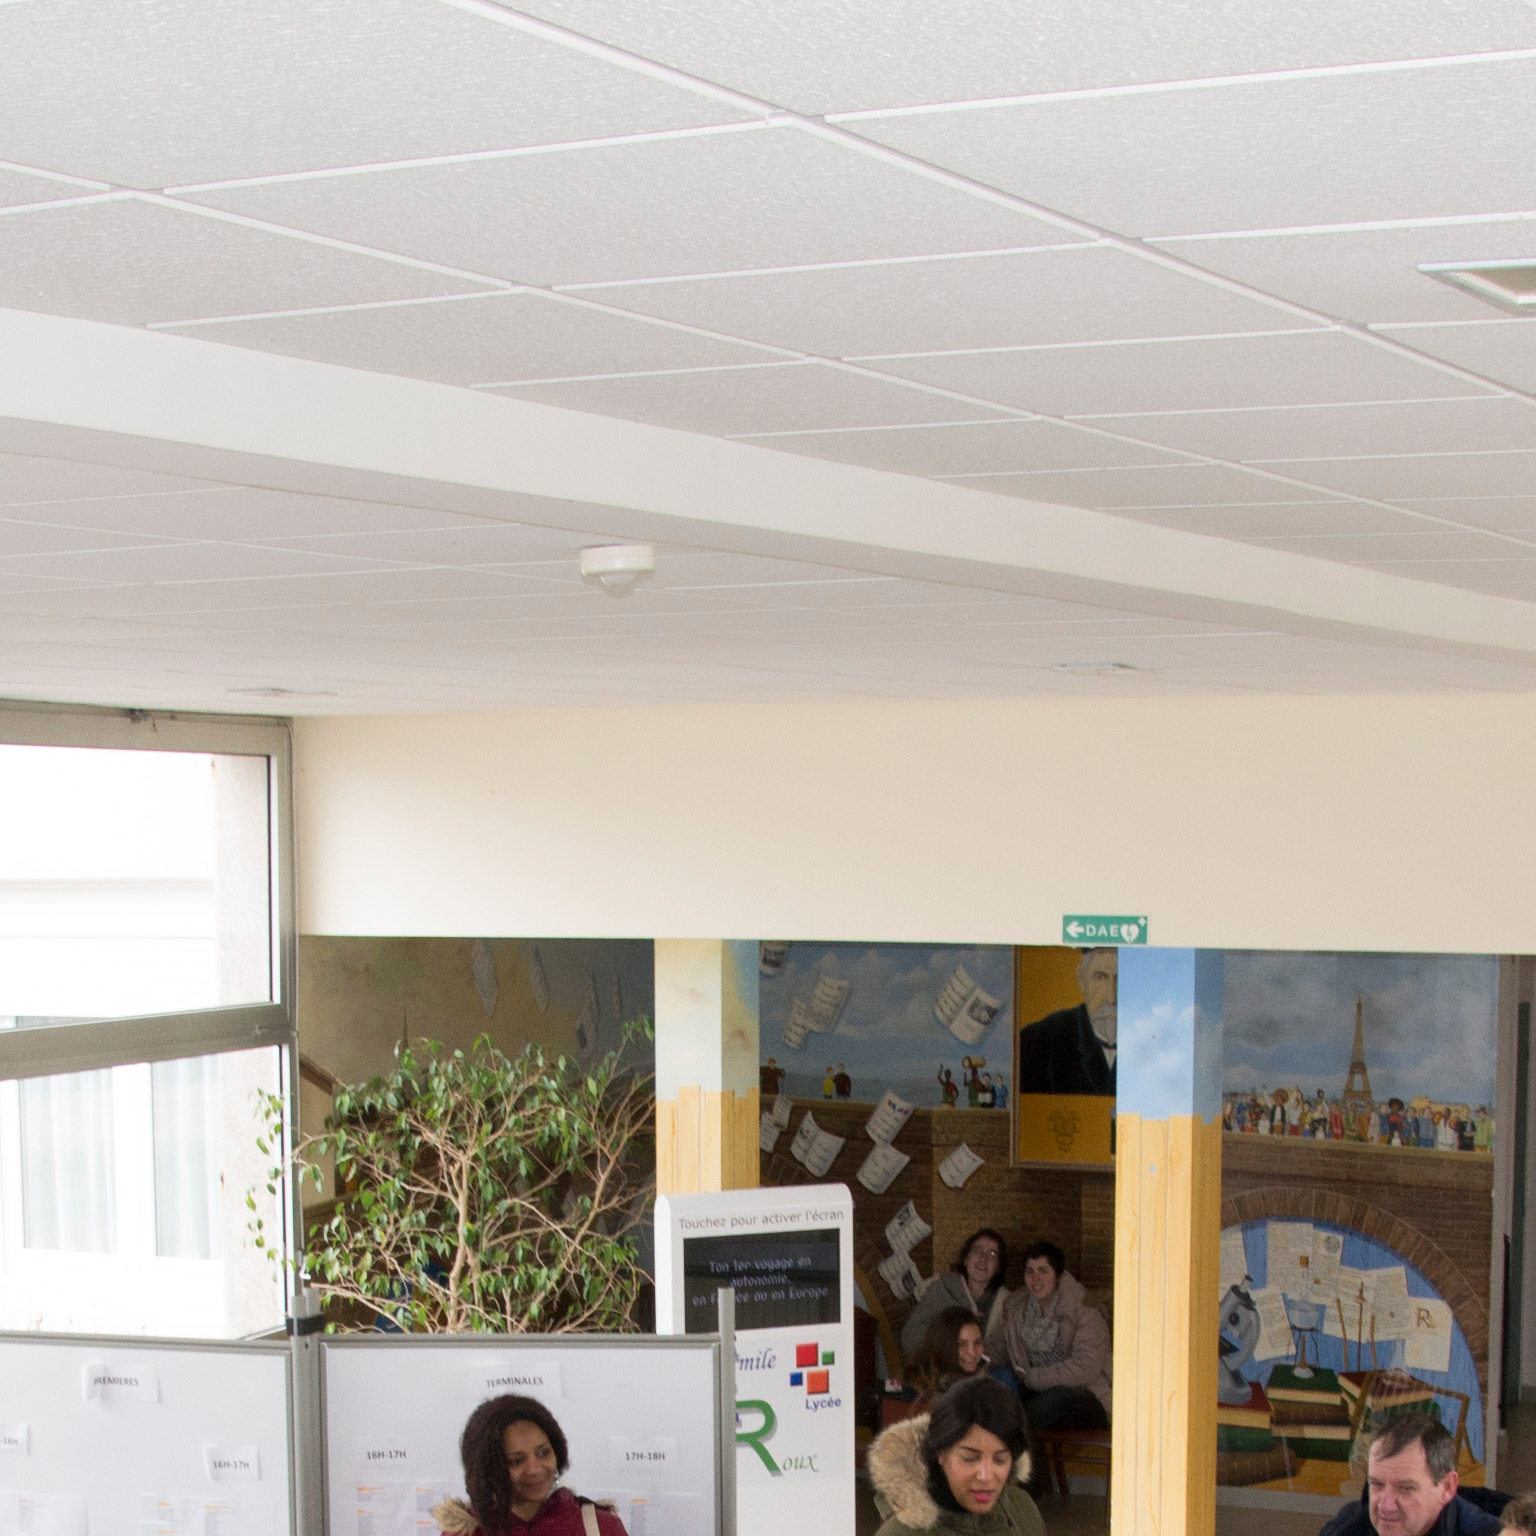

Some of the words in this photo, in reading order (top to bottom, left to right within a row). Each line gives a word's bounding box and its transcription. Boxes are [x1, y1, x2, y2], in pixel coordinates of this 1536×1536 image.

[1085, 923, 1119, 938] DAE
[678, 1216, 726, 1231] Touchez
[730, 1215, 758, 1229] pour
[761, 1210, 803, 1225] activer
[805, 1209, 845, 1222] l'écran
[754, 1256, 794, 1273] voyage
[797, 1256, 813, 1268] en
[692, 1295, 707, 1307] en
[710, 1291, 750, 1306] Fce
[753, 1291, 768, 1303] ou
[771, 1288, 786, 1300] en
[789, 1285, 829, 1300] Europe
[735, 1347, 777, 1372] mile
[486, 1375, 544, 1388] TERMINALES
[805, 1396, 842, 1412] Lycée
[366, 1449, 407, 1460] 16H-17H
[625, 1451, 666, 1461] 17H-18H
